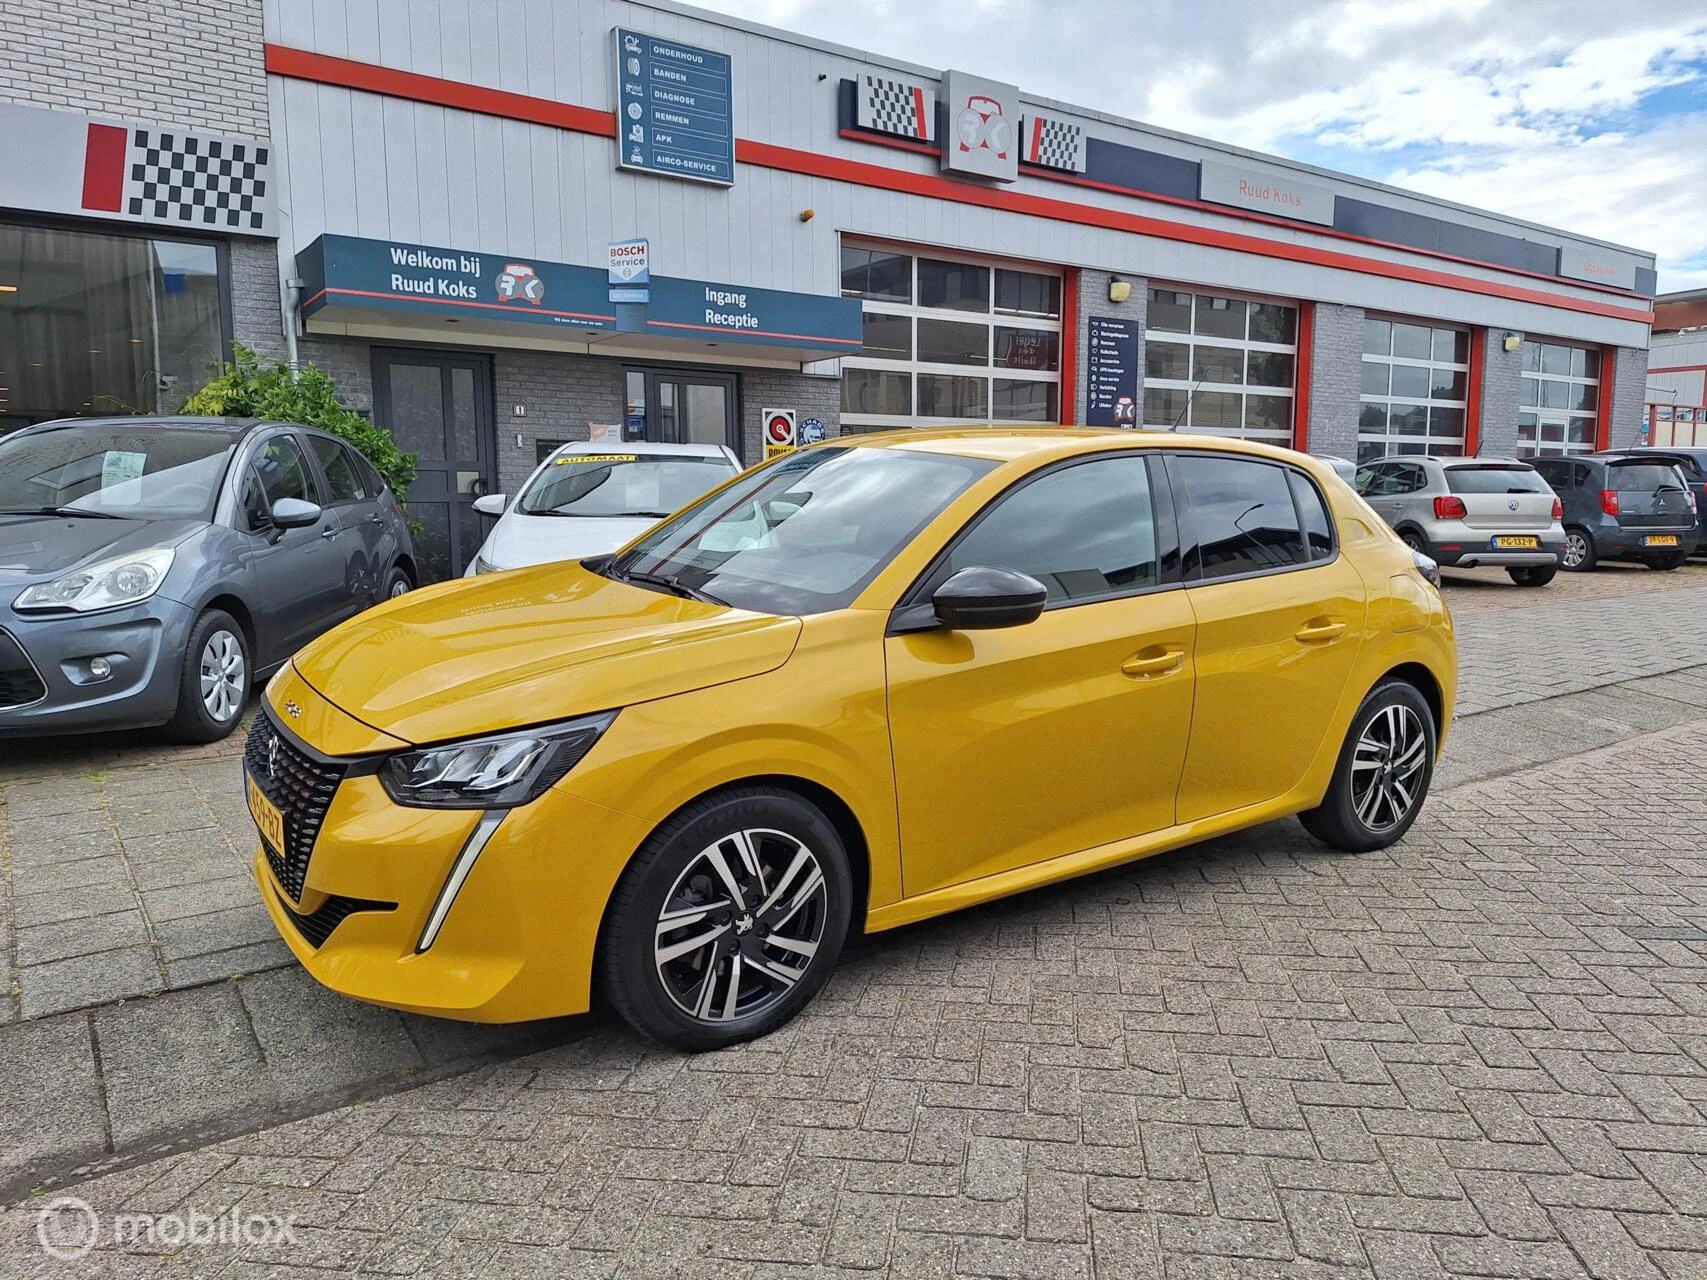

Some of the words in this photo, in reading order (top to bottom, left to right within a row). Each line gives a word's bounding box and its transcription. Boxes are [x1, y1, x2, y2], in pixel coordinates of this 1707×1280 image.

[653, 46, 703, 63] ONDERHOUD
[653, 68, 687, 81] BANDEN
[654, 90, 695, 105] DIAGNOSE
[655, 111, 689, 125] REMMEN
[655, 134, 672, 143] APK
[656, 155, 716, 172] AIRCO-SERVICE
[1239, 179, 1269, 200] Ruud
[1273, 187, 1302, 206] Koks
[610, 246, 645, 257] BOSCH
[390, 247, 457, 272] Welkom
[460, 255, 481, 278] bij
[610, 258, 645, 267] Service
[391, 273, 435, 294] Ruud
[438, 279, 477, 299] Koks
[705, 287, 747, 308] Ingang
[705, 308, 759, 329] Receptie
[562, 455, 632, 463] AUTOMAAT
[1500, 538, 1533, 546] PG-132-P
